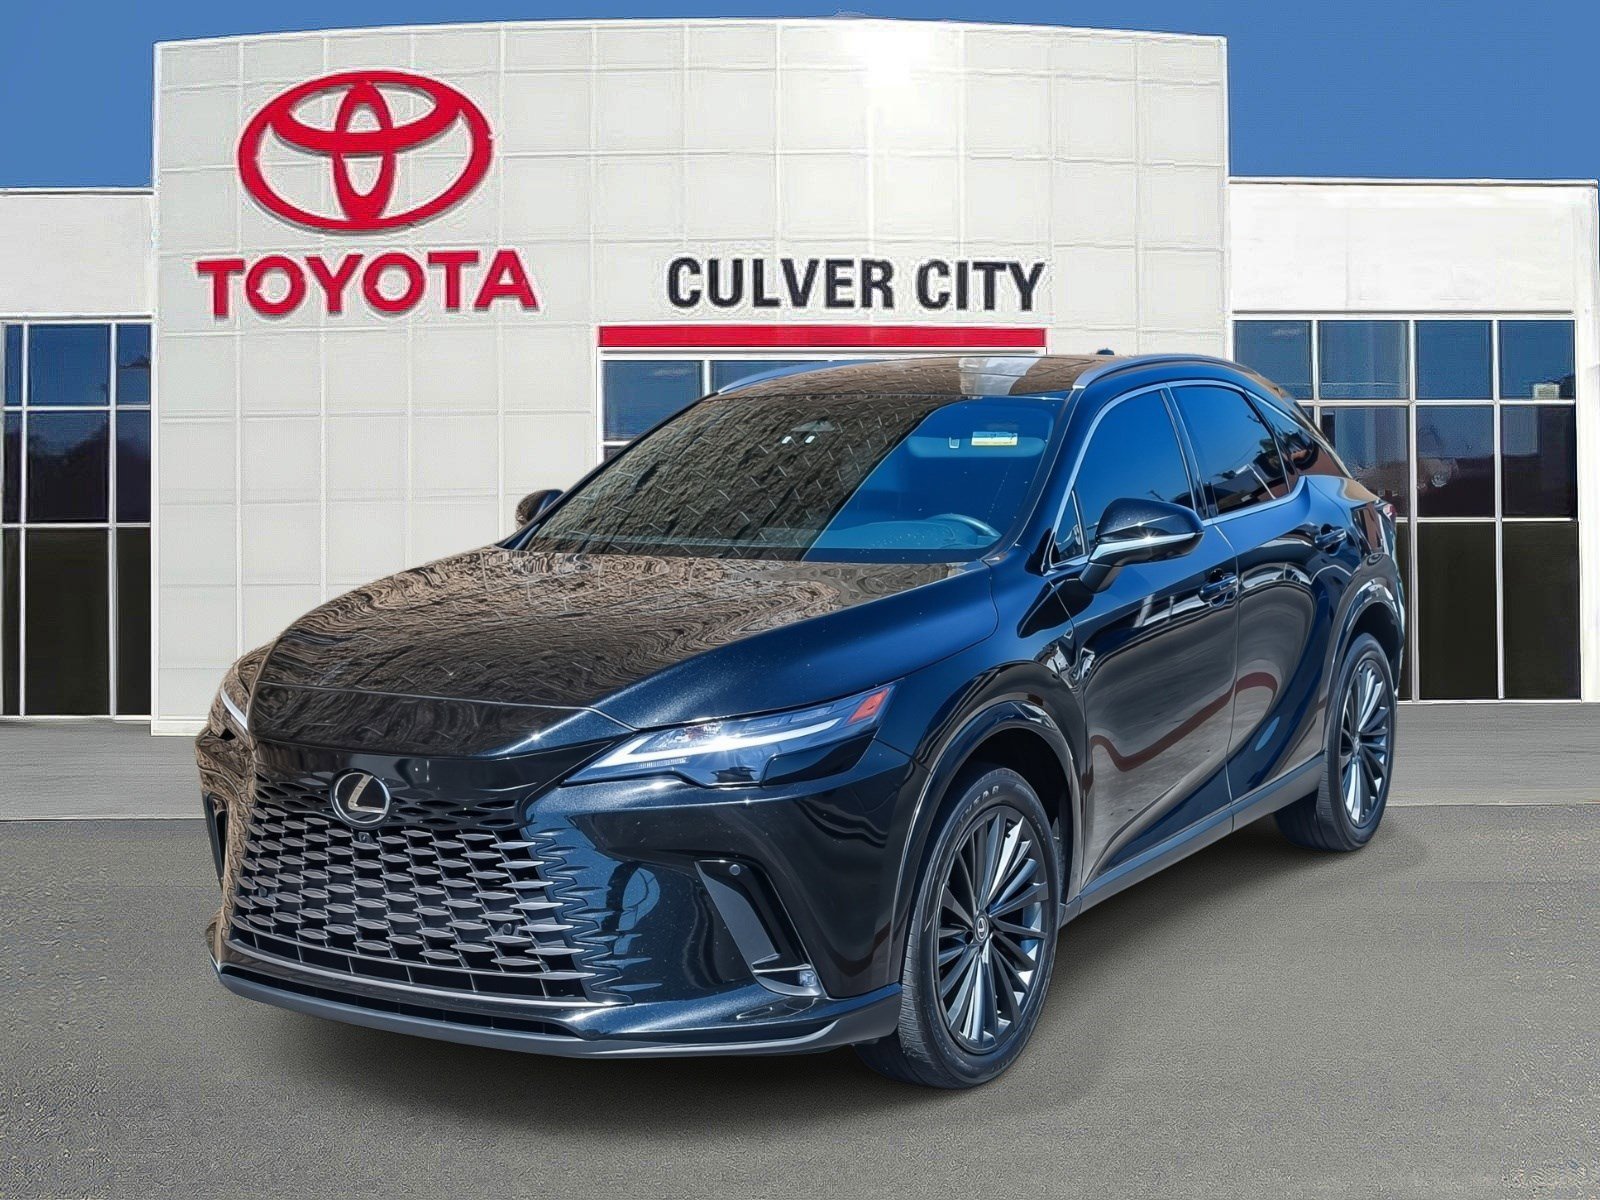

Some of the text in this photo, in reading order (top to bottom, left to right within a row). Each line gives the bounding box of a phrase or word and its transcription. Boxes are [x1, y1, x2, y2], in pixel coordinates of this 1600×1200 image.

[197, 250, 538, 316] TOYOTA
[667, 257, 1046, 312] CULVER CITY
